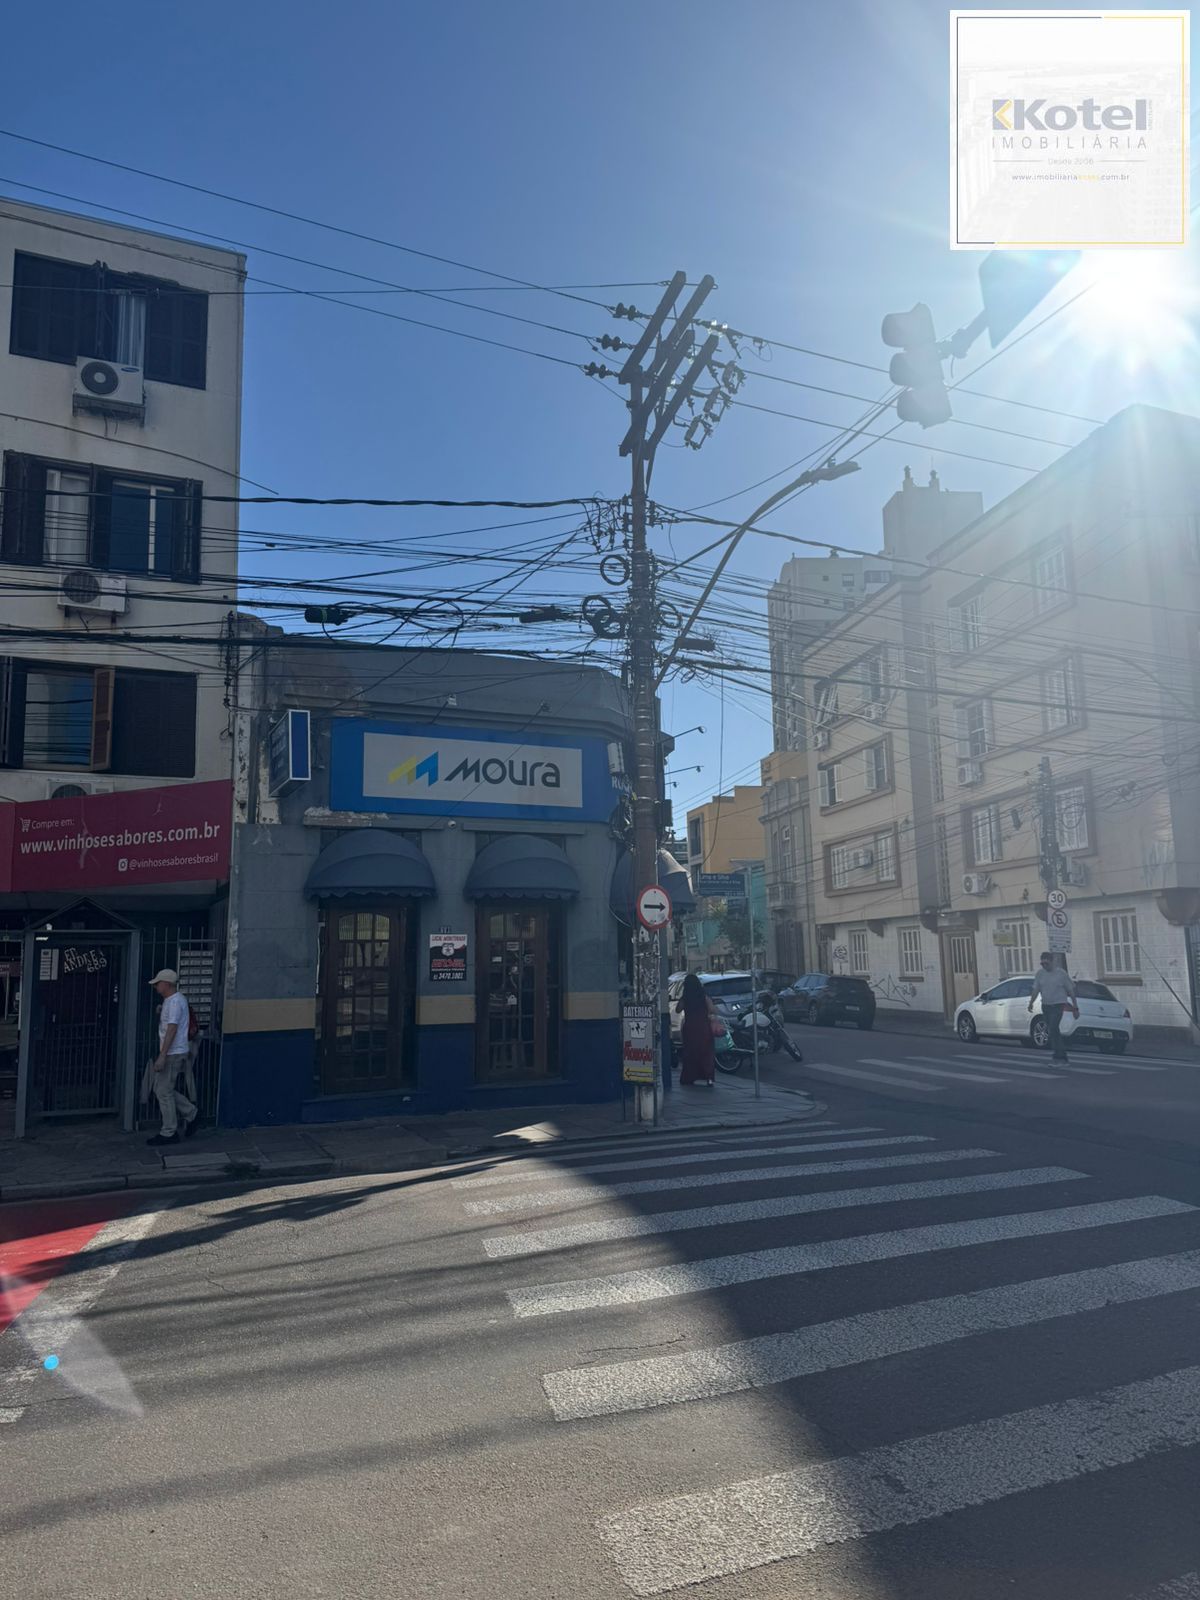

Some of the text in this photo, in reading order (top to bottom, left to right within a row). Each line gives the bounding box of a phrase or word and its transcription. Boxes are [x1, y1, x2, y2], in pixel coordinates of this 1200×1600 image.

[31, 817, 75, 831] Compre em:
[20, 821, 221, 854] www.vinhosesabores.com.br
[129, 852, 219, 871] @vinhosesaboresbrasil
[1051, 893, 1063, 903] 30
[623, 1006, 653, 1017] BATERIAS
